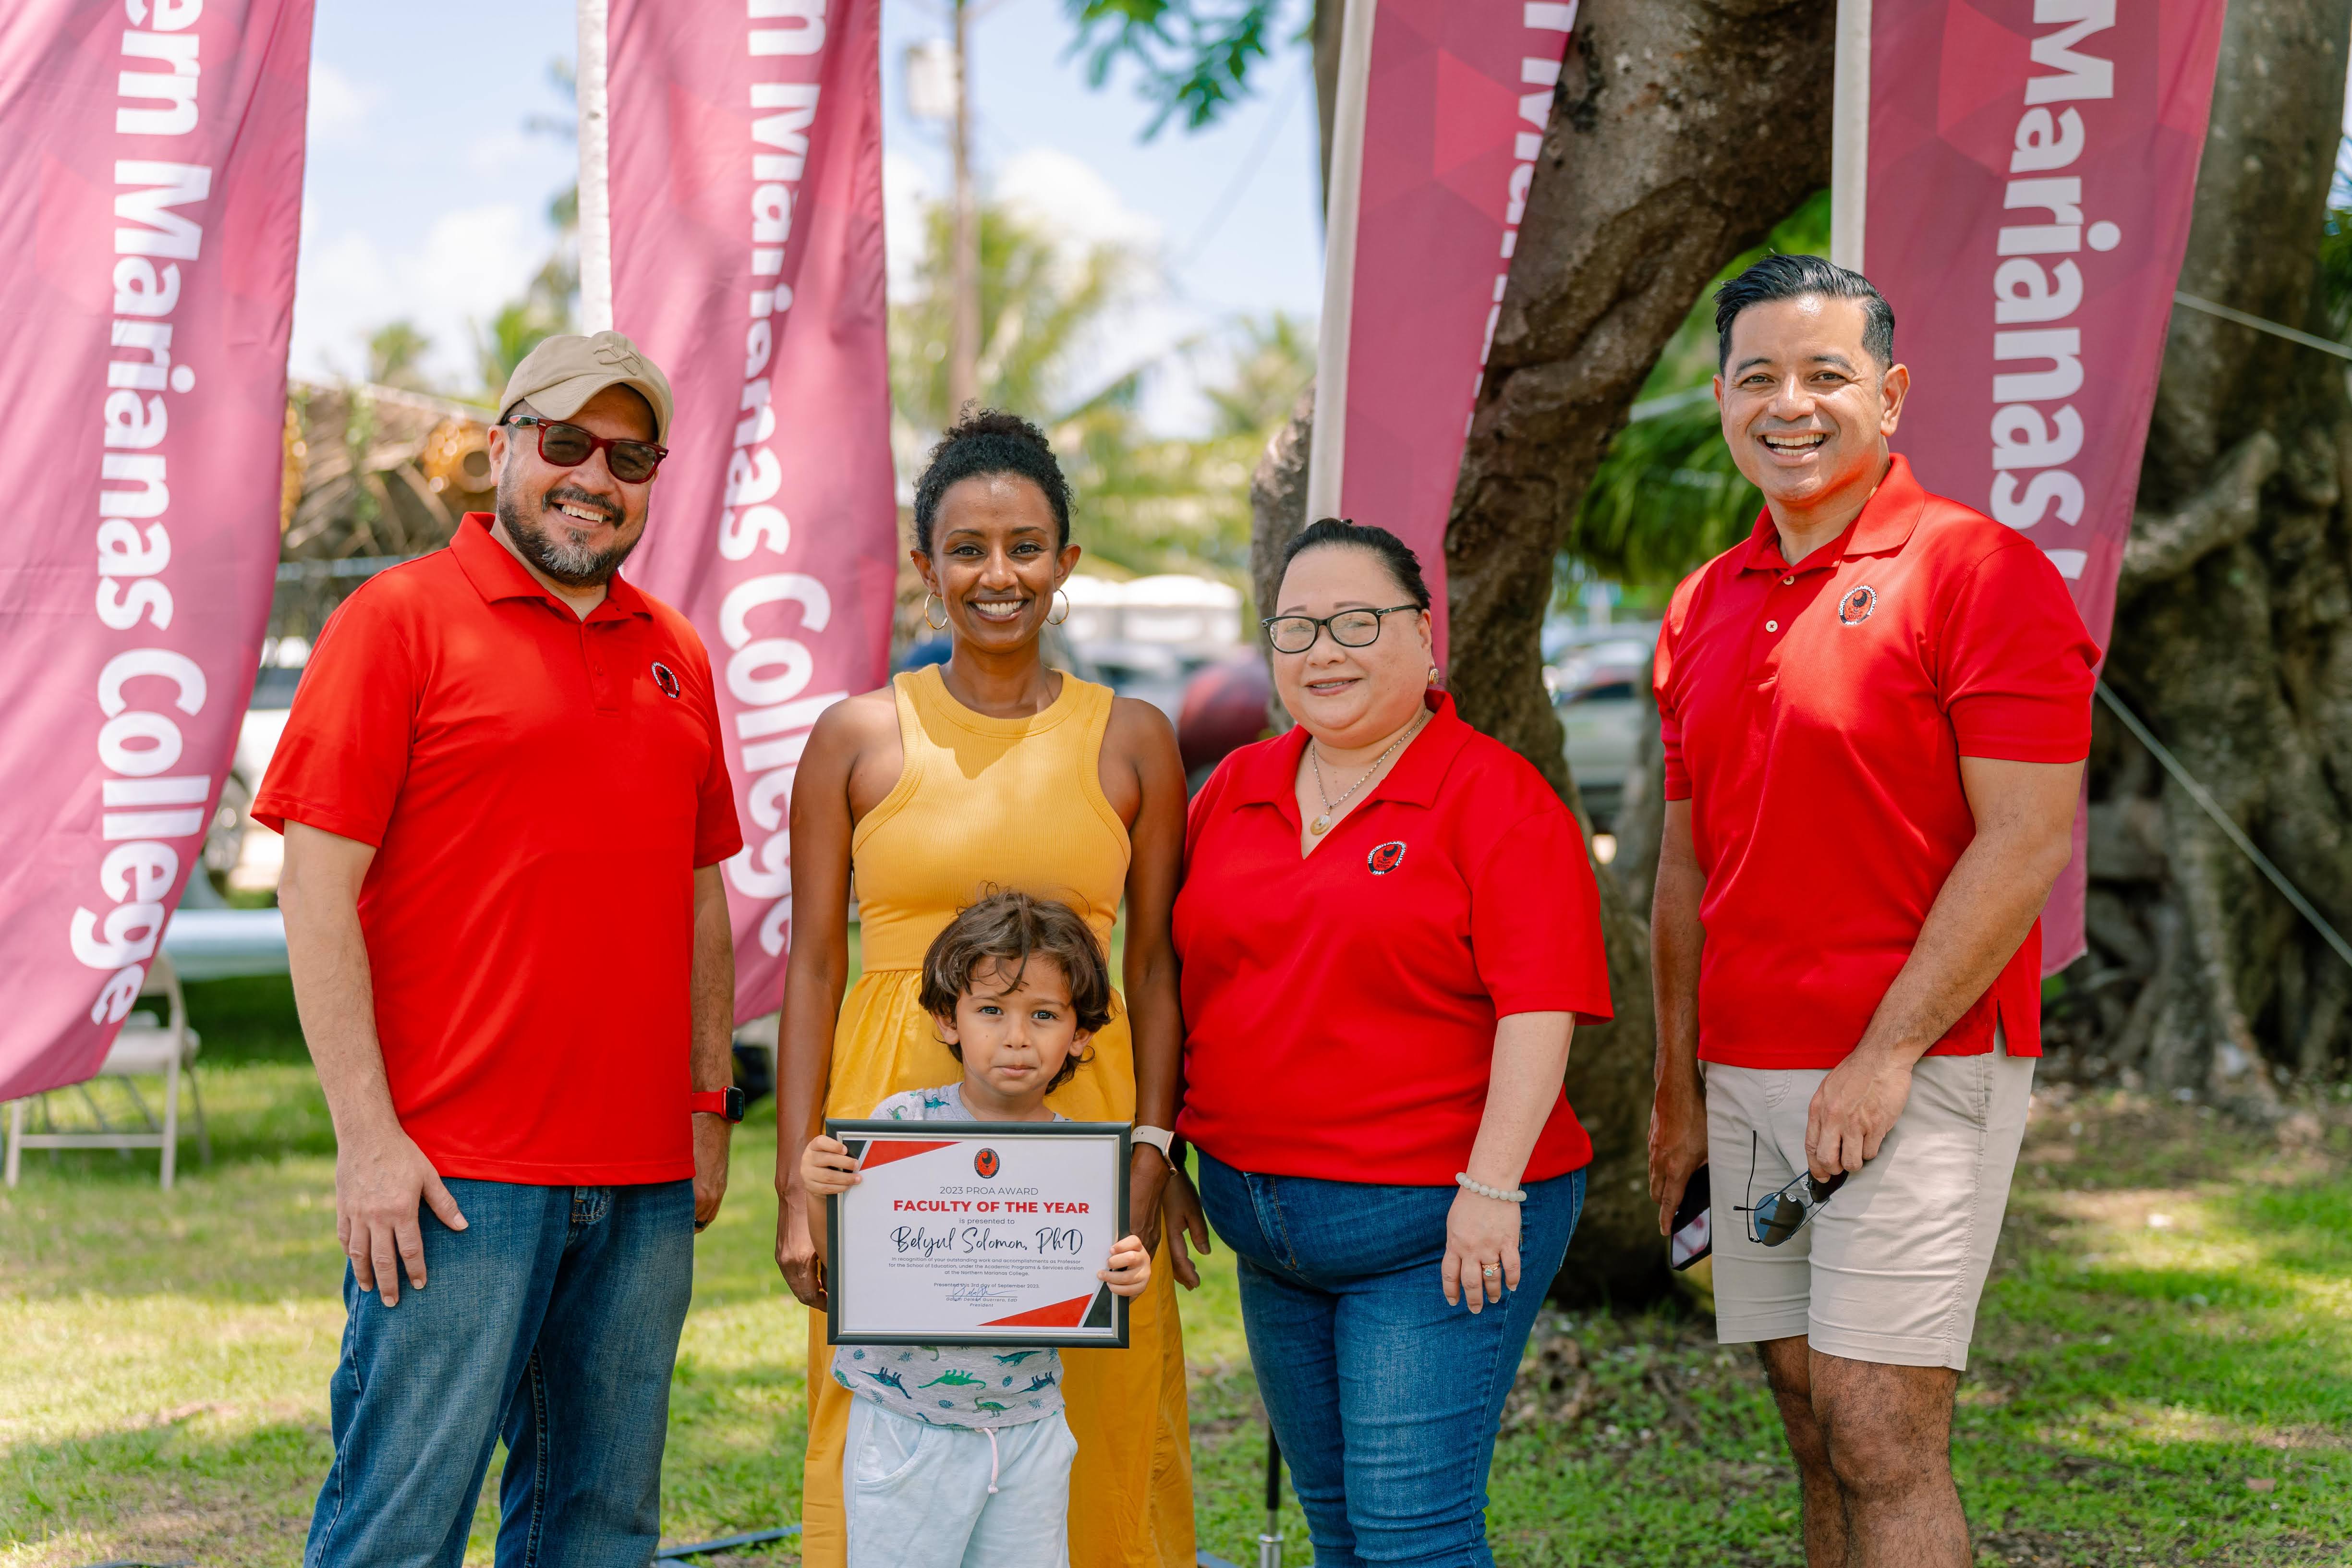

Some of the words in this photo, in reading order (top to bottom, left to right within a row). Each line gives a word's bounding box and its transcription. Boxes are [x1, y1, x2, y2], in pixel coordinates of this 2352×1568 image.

[1989, 0, 2122, 529] Marianas
[97, 159, 213, 630] Marianas
[70, 648, 211, 1026] College
[894, 1200, 972, 1212] FACULTY
[977, 1201, 1000, 1213] OF
[1005, 1202, 1038, 1213] THE
[1043, 1202, 1090, 1214] YEAR
[962, 1227, 1027, 1253] Solomon,
[1036, 1227, 1083, 1255] PhD
[998, 1187, 1039, 1195] AWARD
